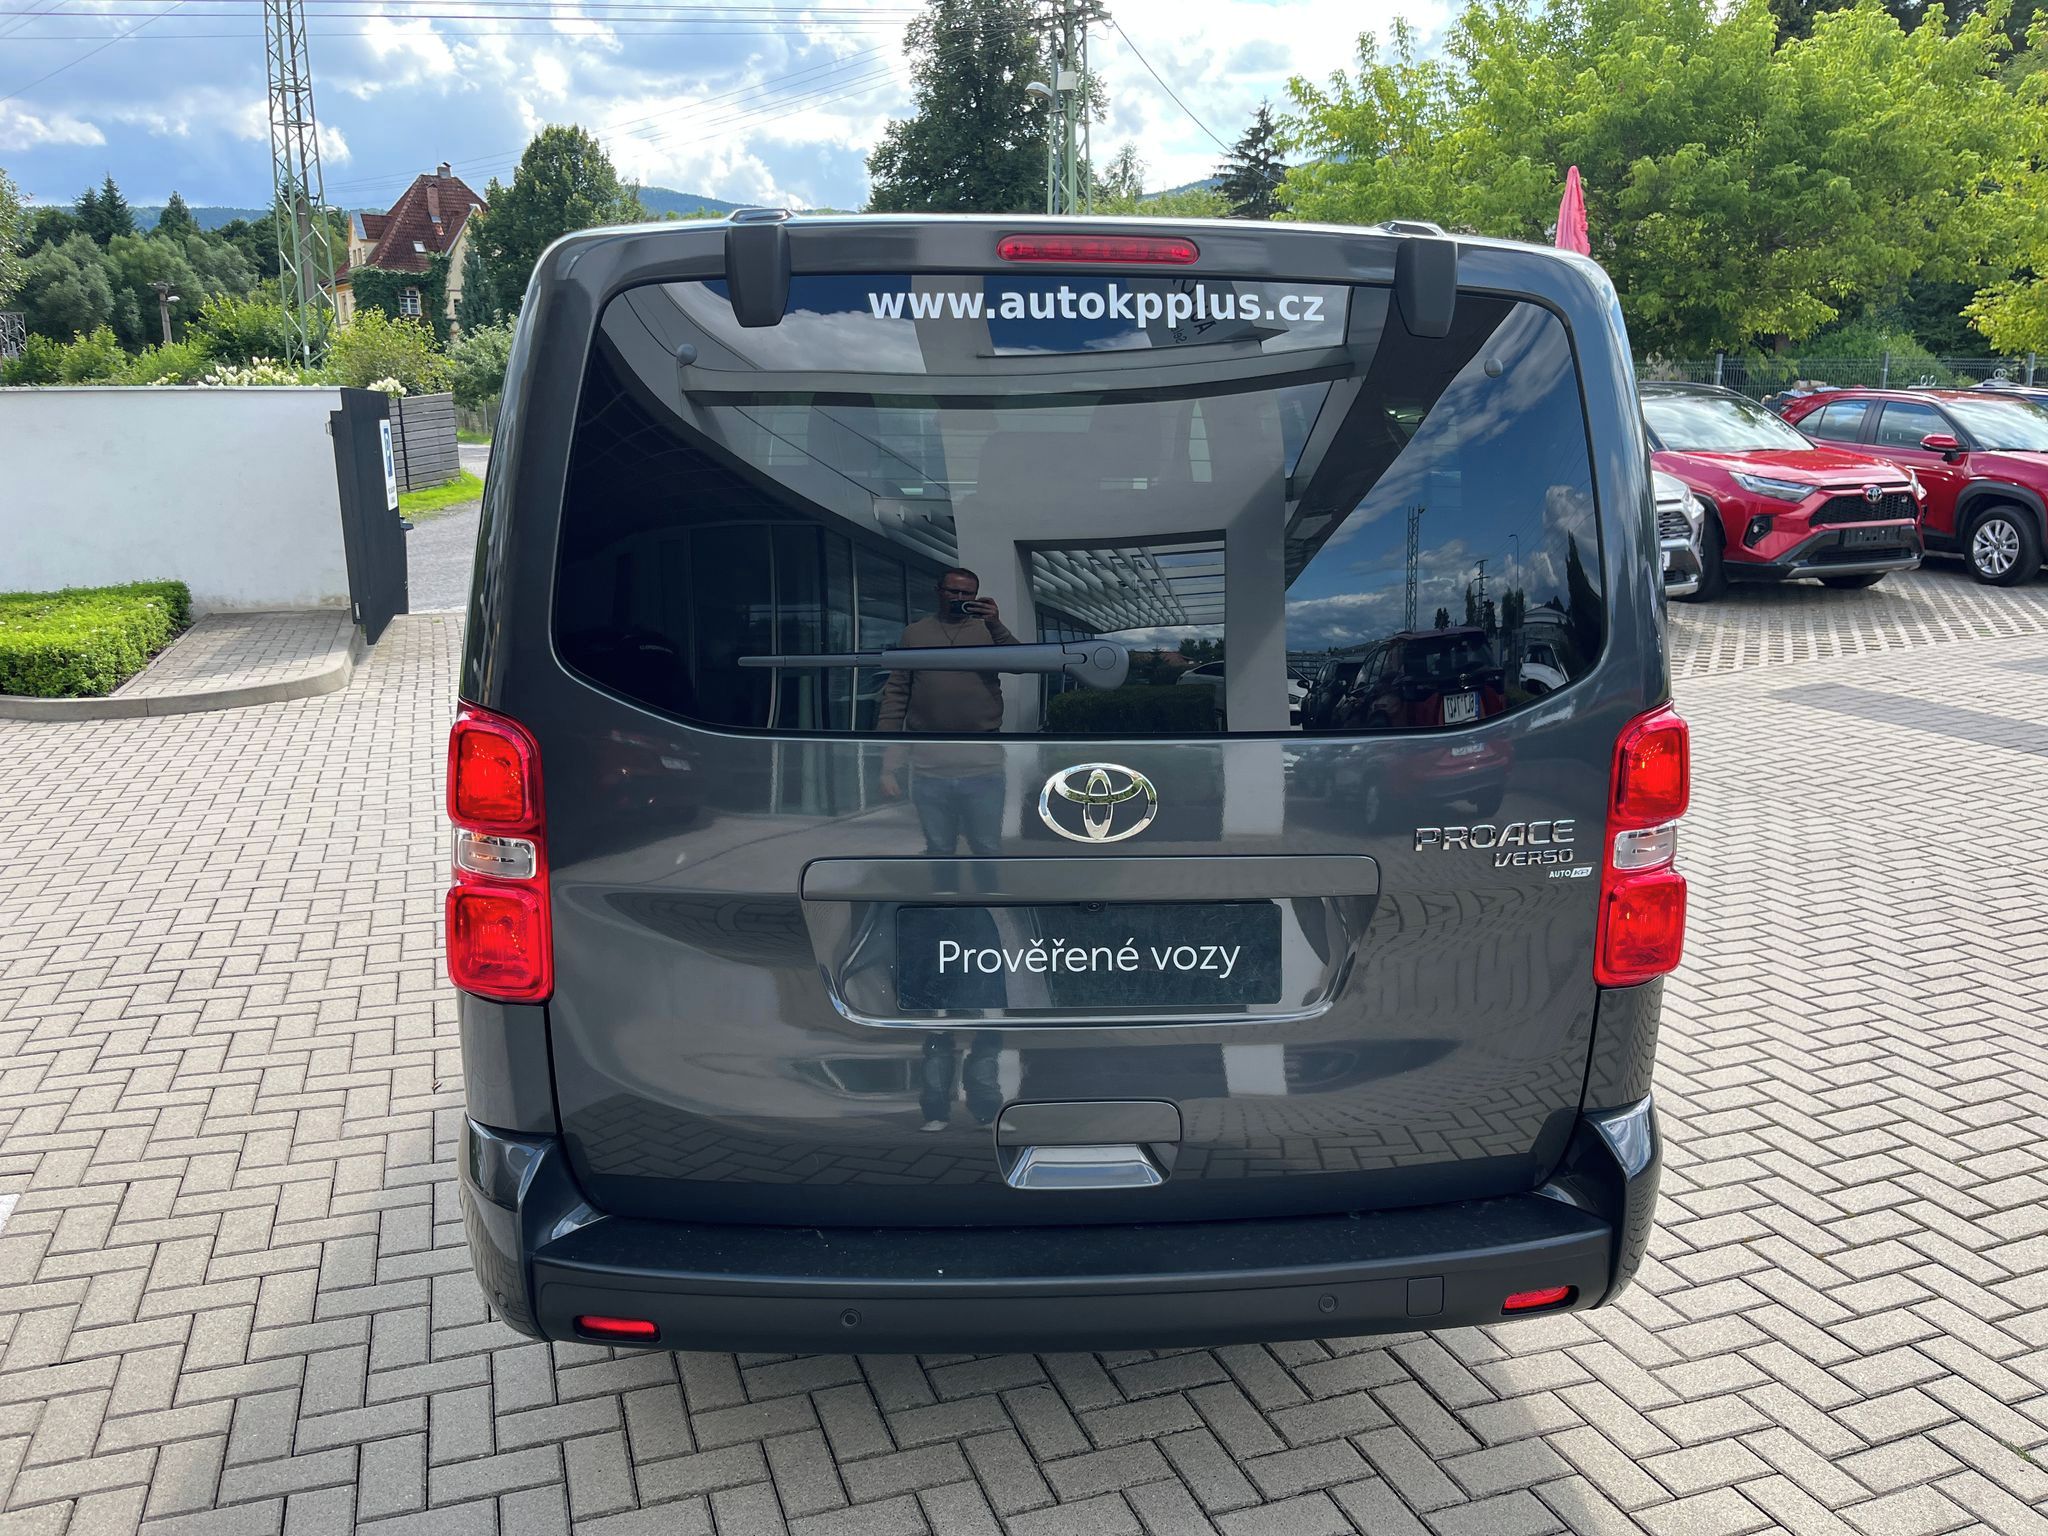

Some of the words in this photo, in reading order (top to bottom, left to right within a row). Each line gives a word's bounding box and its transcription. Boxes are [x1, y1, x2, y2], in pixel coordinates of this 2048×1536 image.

[868, 284, 1325, 328] www.autokpplus.cz
[1415, 819, 1576, 852] PROACE
[1494, 848, 1574, 867] VERSO
[1548, 869, 1571, 879] AUTO
[938, 937, 1139, 974] Prověřené
[1150, 944, 1241, 979] vozy
